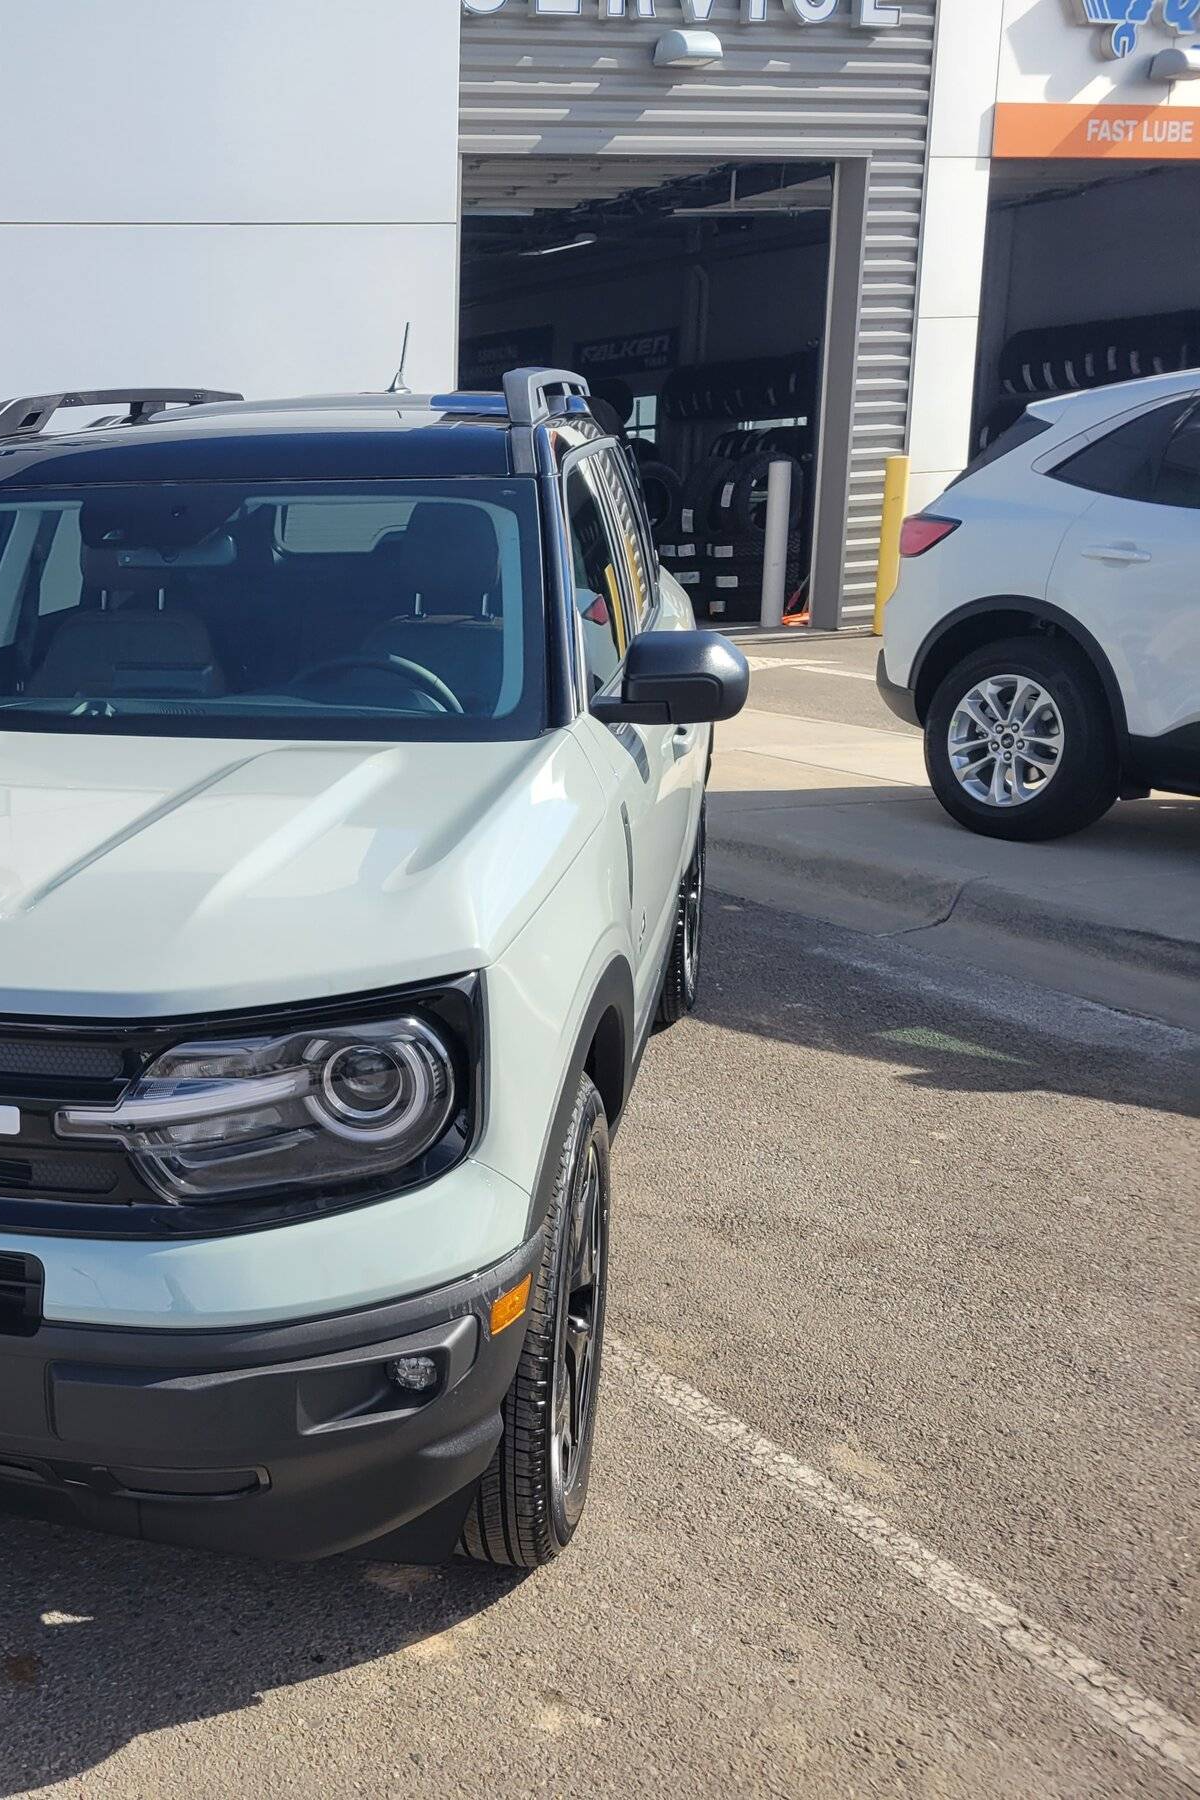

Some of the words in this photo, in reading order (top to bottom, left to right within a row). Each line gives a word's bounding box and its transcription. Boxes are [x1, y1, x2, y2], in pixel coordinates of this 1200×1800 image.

[1086, 119, 1138, 143] FAST
[1142, 120, 1194, 144] LUBE
[581, 334, 670, 363] FALKEN
